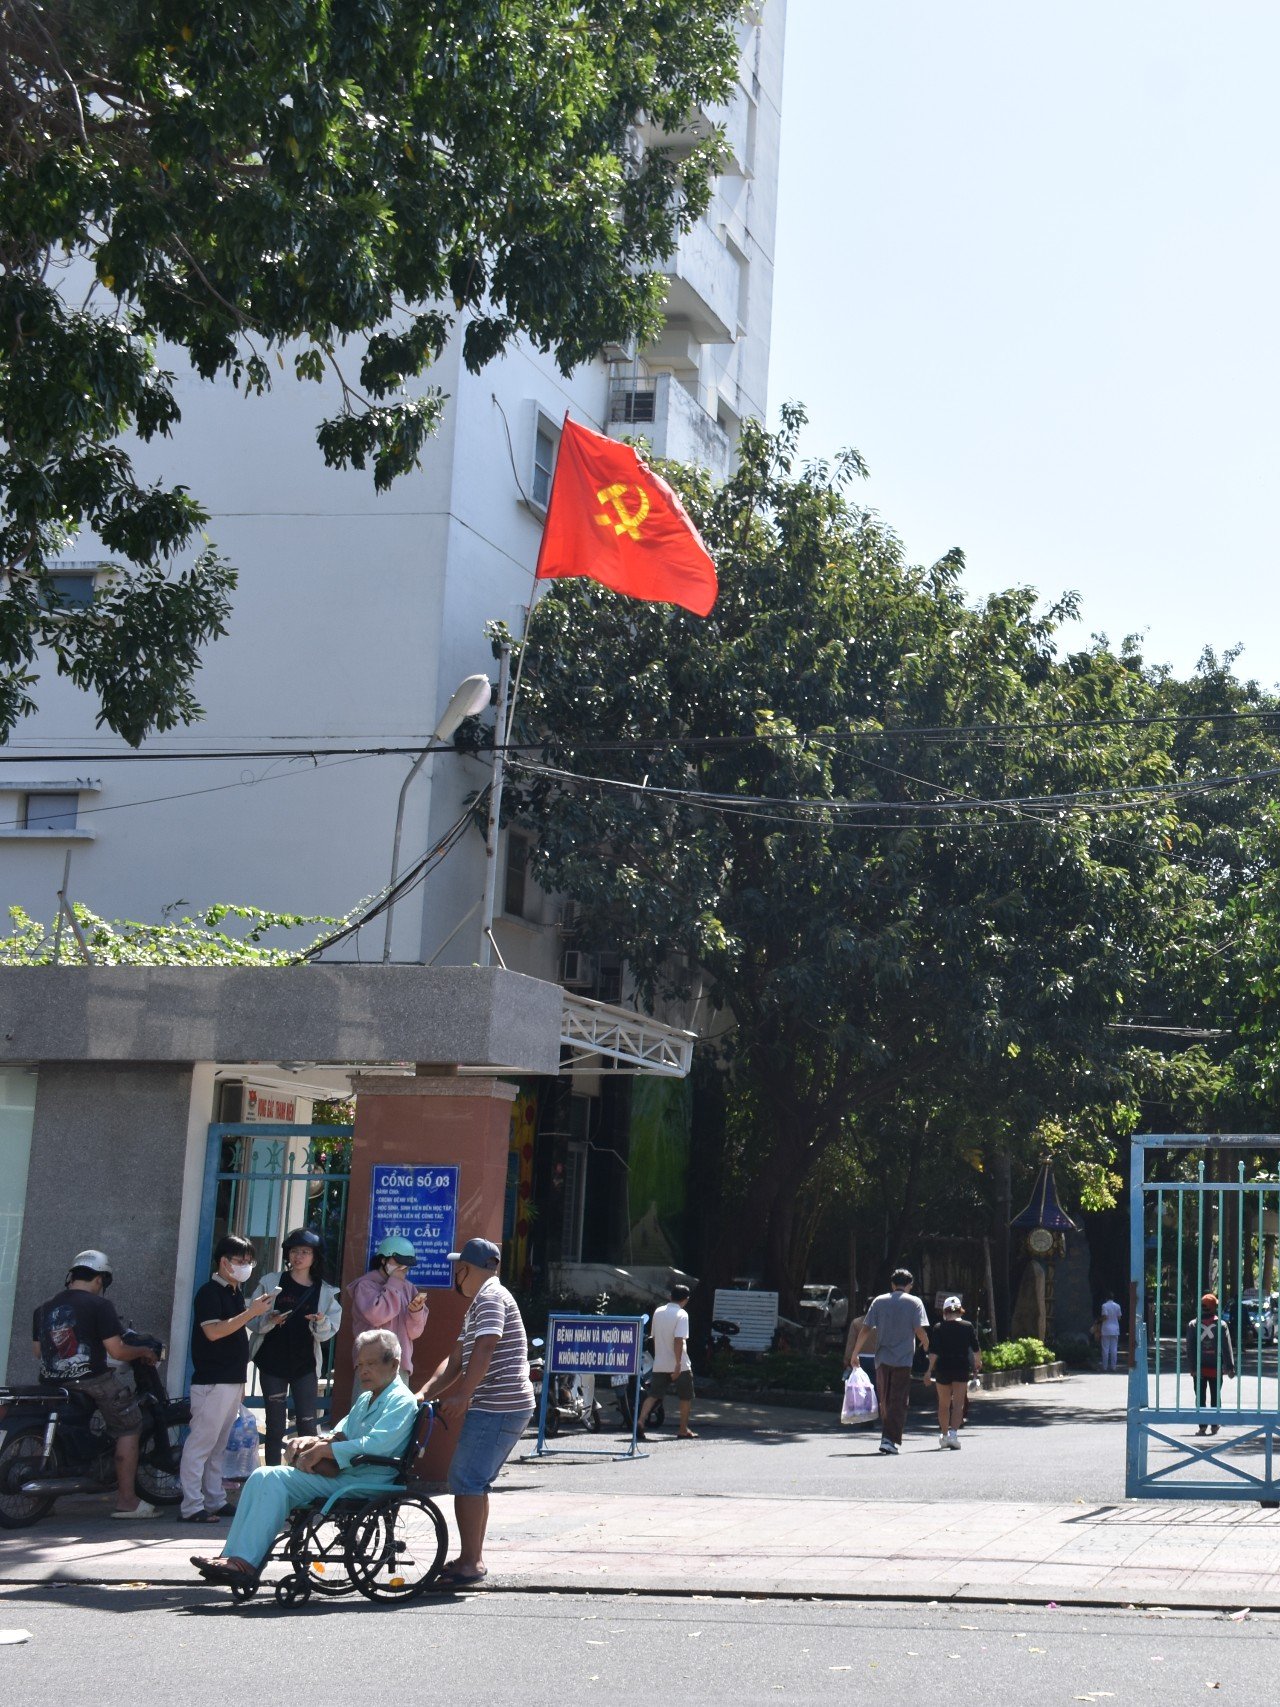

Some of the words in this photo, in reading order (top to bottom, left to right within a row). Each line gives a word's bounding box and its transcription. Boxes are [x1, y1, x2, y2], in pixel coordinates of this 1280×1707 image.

[381, 1170, 413, 1187] CỔNG
[417, 1171, 433, 1187] SỐ
[436, 1175, 450, 1187] 03
[557, 1326, 574, 1344] BỆNH
[574, 1326, 591, 1343] NHÂN
[592, 1327, 600, 1343] VÀ
[601, 1327, 620, 1344] NGƯỜI
[620, 1327, 633, 1344] NHÀ
[558, 1348, 579, 1365] KHÔNG
[580, 1350, 597, 1368] ĐƯỢC
[597, 1352, 604, 1366] ĐI
[605, 1348, 615, 1366] LỐI
[616, 1349, 629, 1366] NÀY
